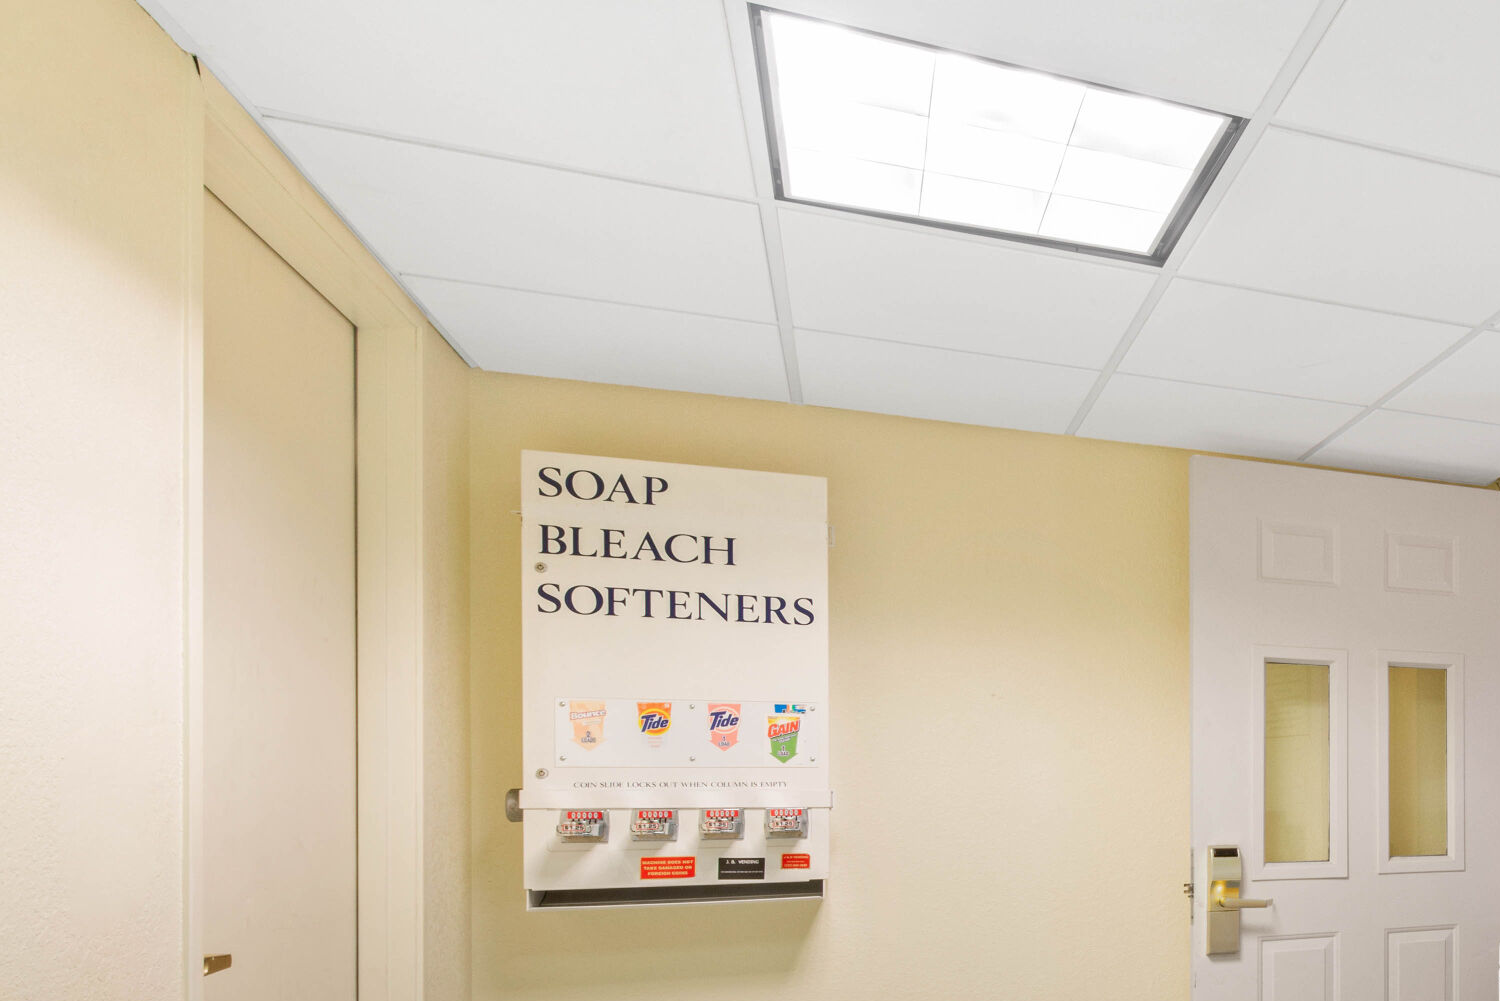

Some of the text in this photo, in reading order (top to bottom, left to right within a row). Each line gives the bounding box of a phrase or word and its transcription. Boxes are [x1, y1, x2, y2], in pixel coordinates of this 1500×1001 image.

[537, 466, 669, 506] SOAP
[538, 523, 738, 566] BLEACH
[536, 582, 816, 627] SOFTENERS
[640, 713, 669, 733] Tide
[709, 710, 739, 731] Tide
[767, 719, 800, 739] GAIN
